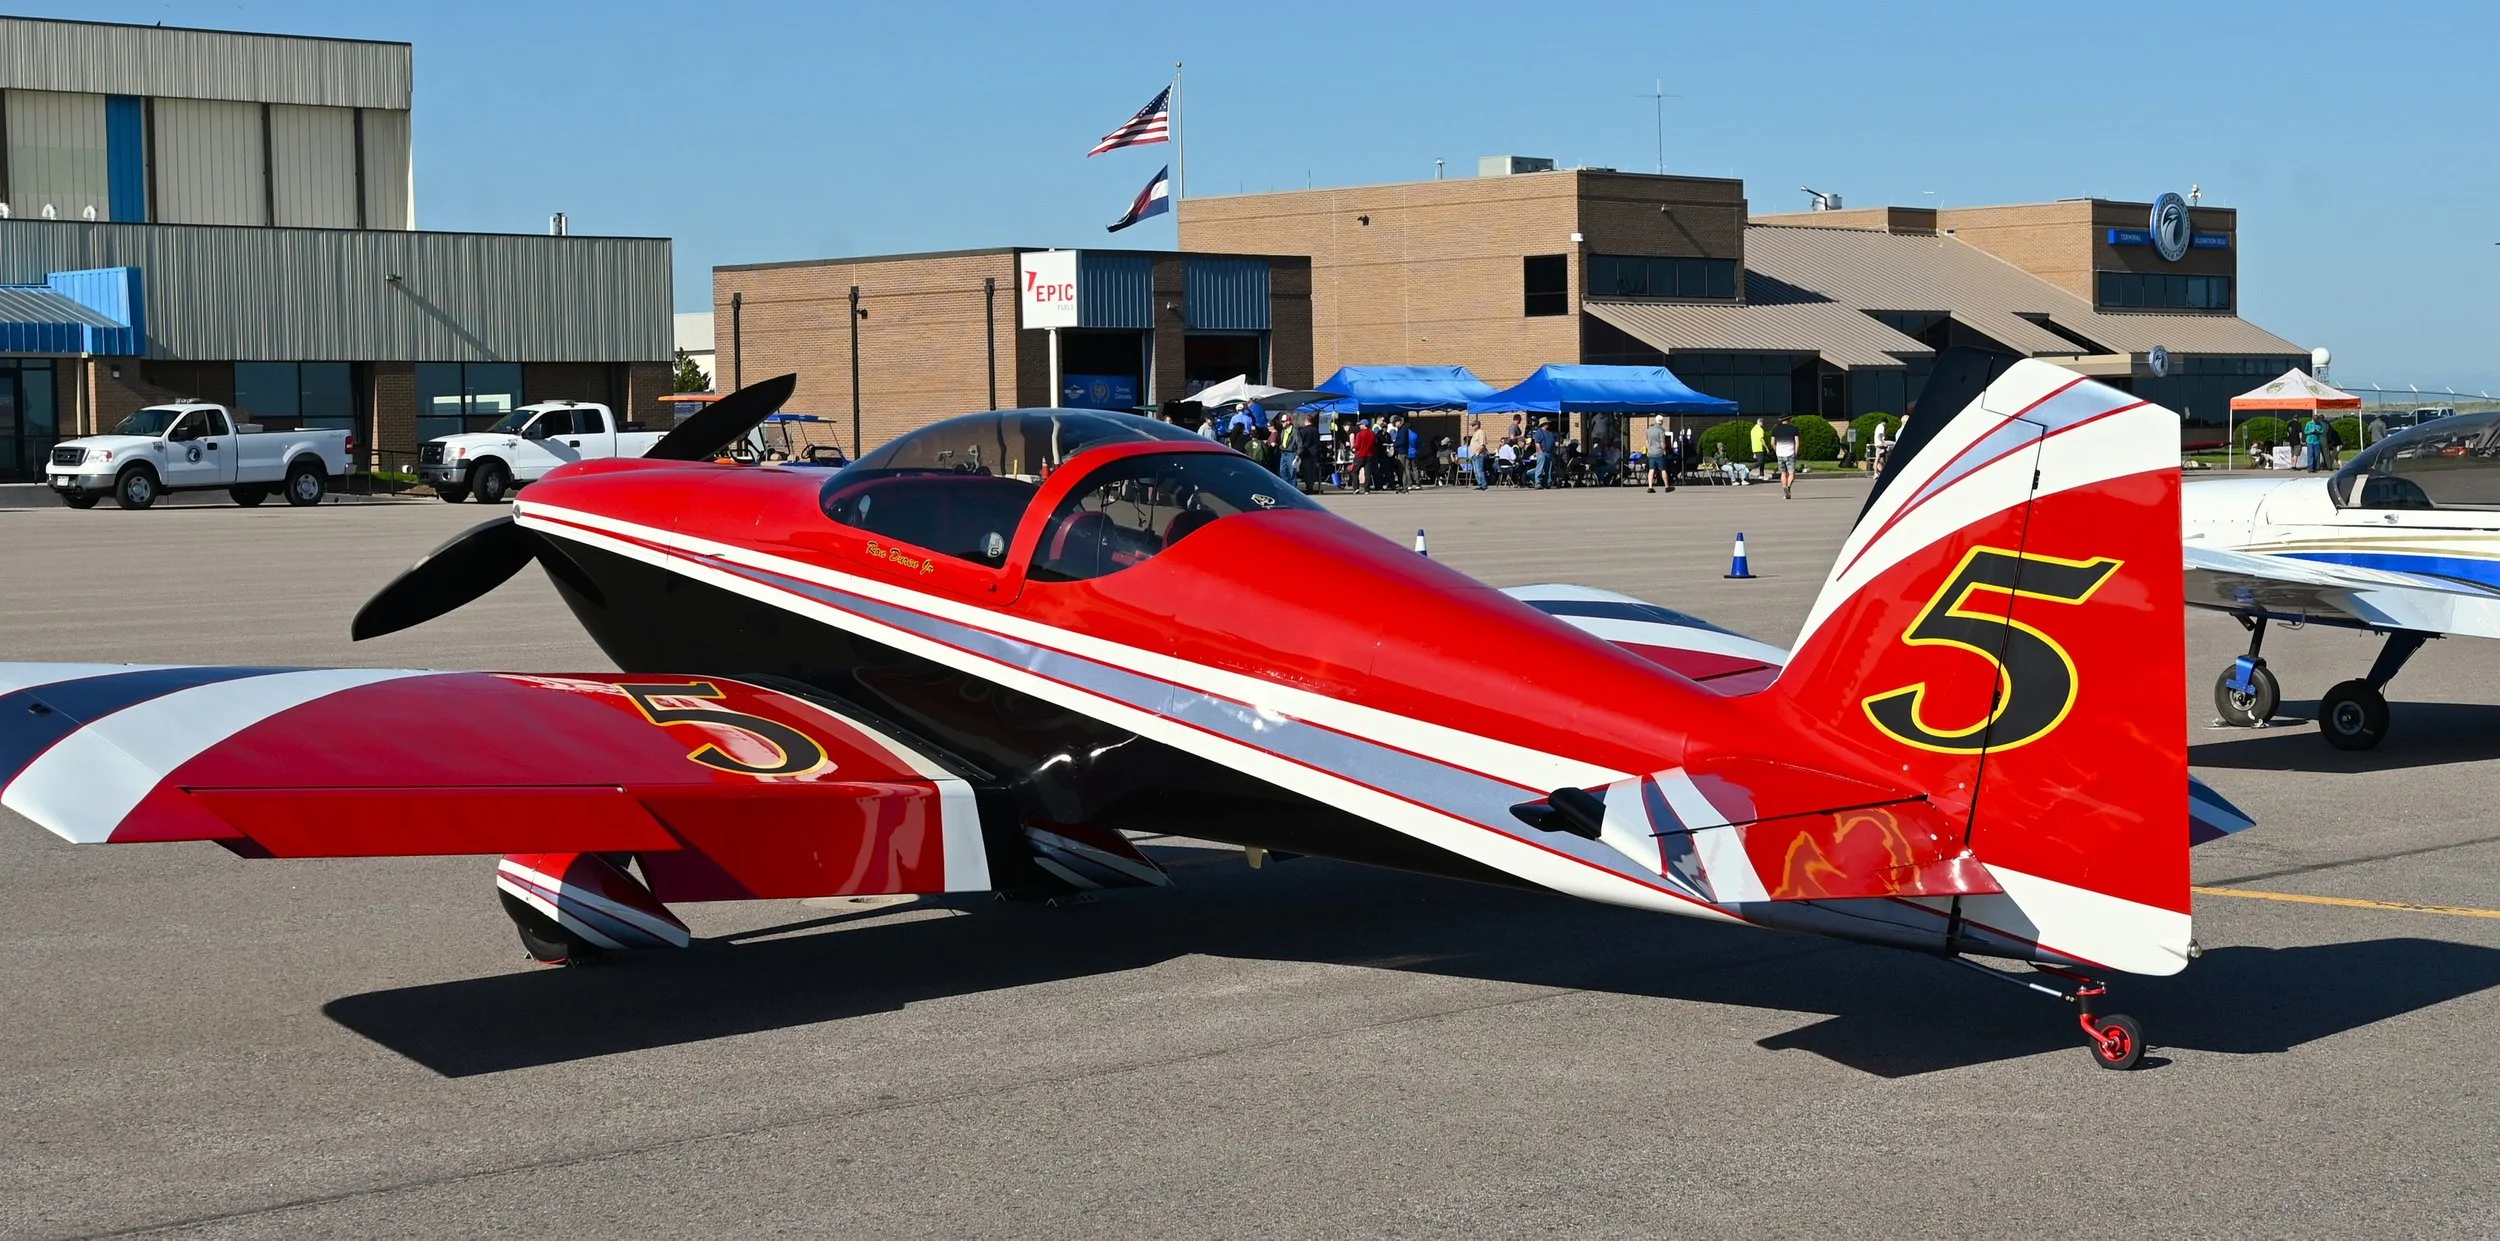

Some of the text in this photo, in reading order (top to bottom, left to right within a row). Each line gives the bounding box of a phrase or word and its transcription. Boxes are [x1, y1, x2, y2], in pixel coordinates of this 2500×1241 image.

[1036, 284, 1073, 302] EPIC
[990, 547, 1000, 556] 5
[1861, 545, 2126, 755] 5
[615, 681, 828, 777] 5
